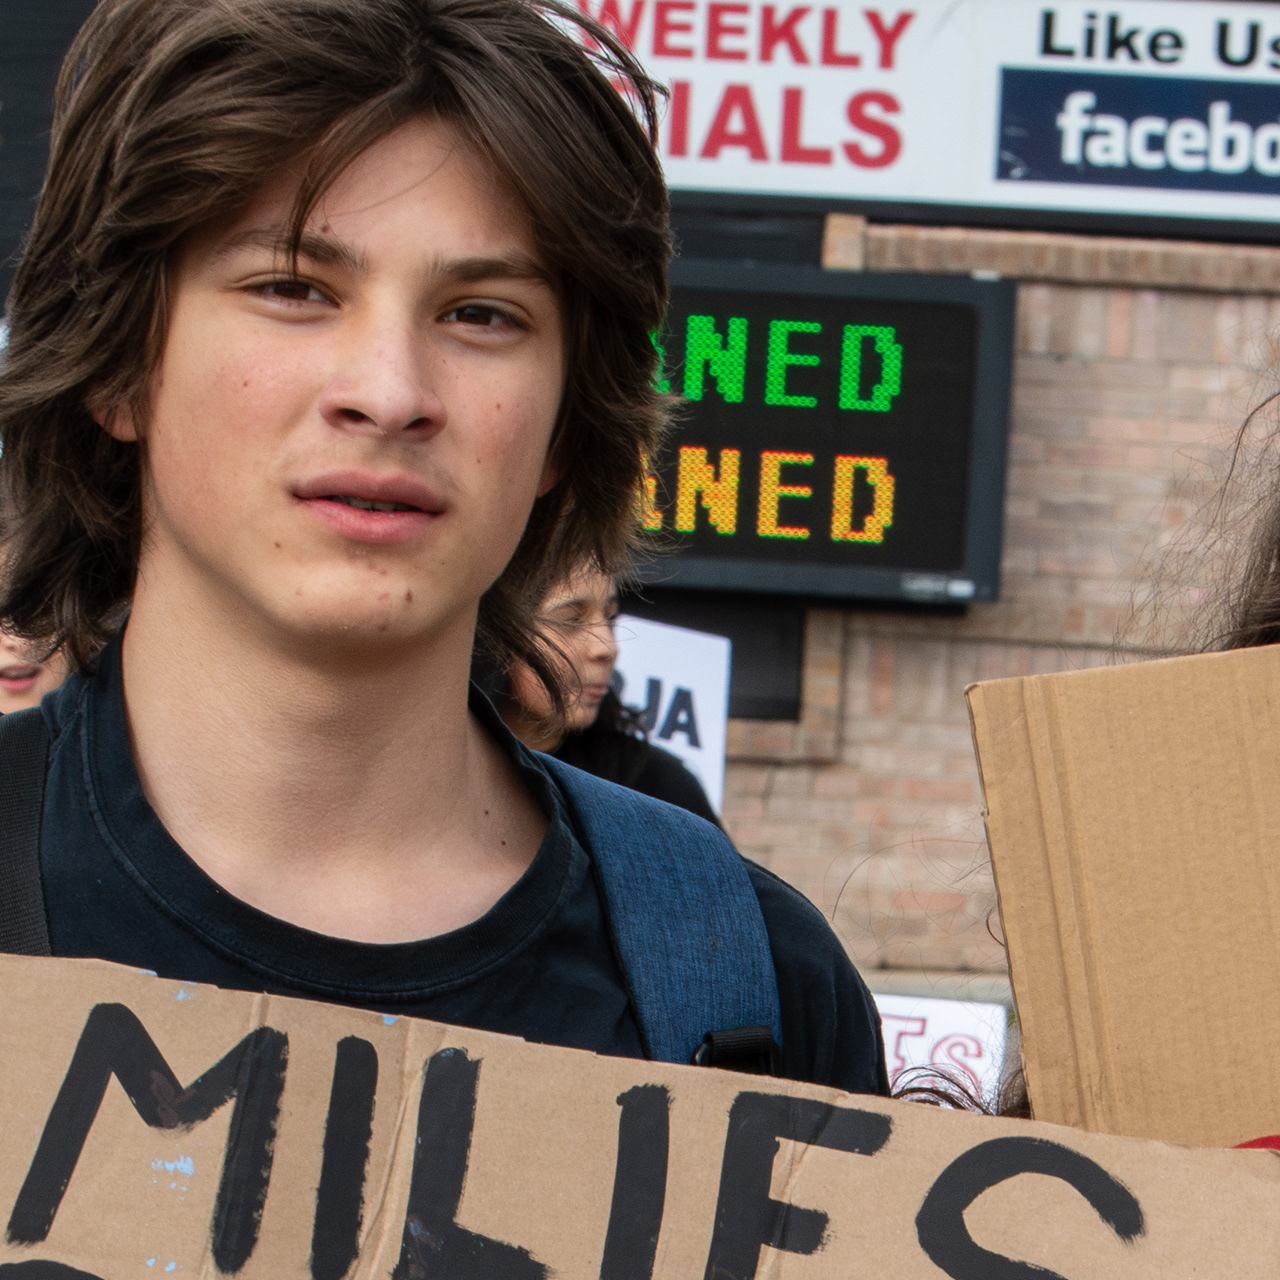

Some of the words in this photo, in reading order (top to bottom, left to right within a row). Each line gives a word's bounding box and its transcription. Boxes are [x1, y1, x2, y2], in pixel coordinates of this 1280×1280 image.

[1038, 9, 1184, 64] Like
[649, 316, 903, 411] NED
[634, 446, 895, 542] NED
